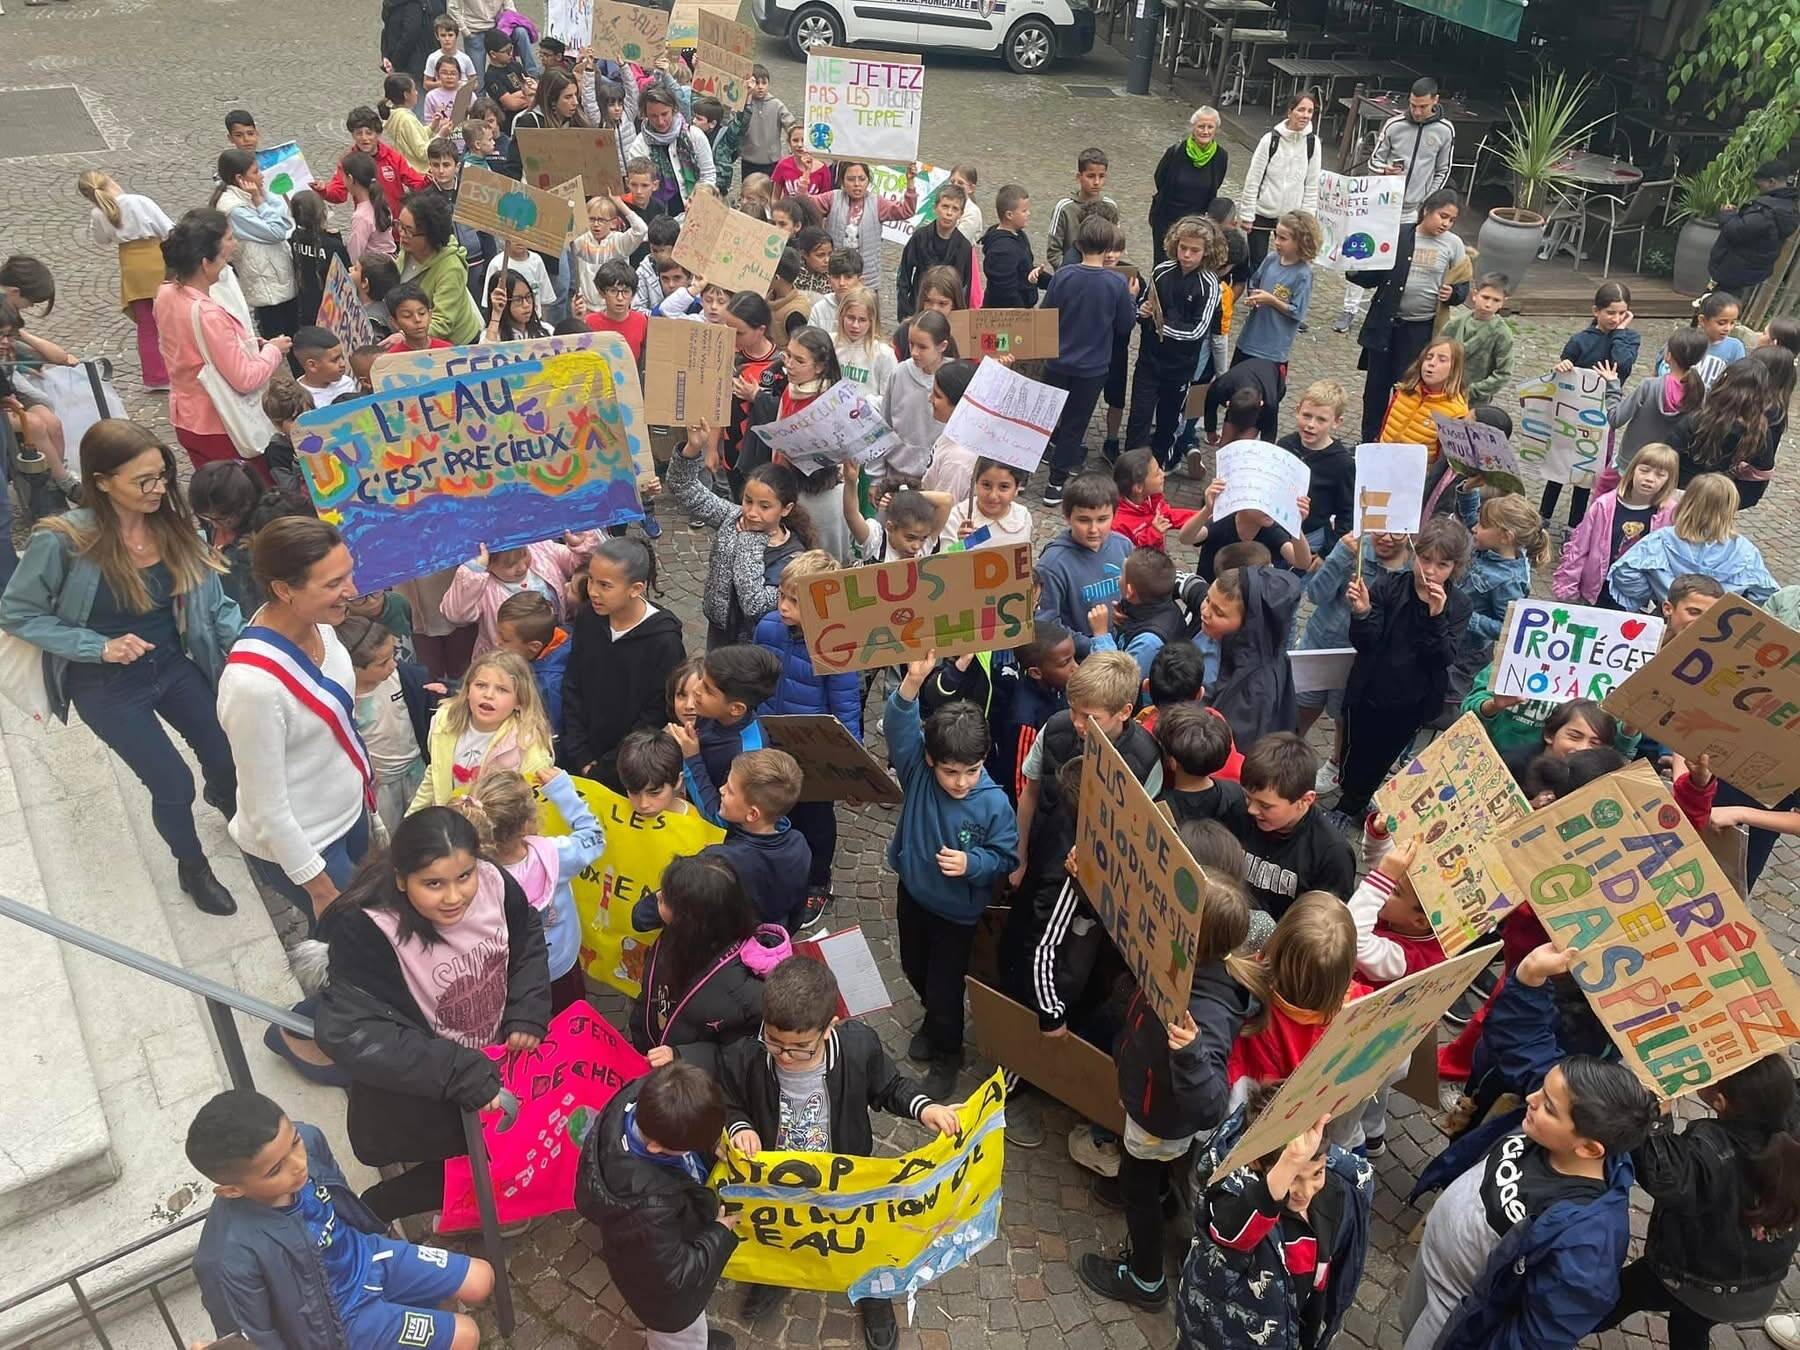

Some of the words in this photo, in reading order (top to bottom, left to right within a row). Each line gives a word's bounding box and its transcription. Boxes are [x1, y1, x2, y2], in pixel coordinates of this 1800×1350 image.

[808, 85, 839, 104] PAS
[846, 86, 870, 107] LES
[816, 59, 841, 84] NE
[849, 61, 923, 89] JETEZ
[808, 105, 833, 122] PAR
[371, 377, 516, 444] L'EAU
[356, 457, 438, 504] C'EST
[809, 554, 946, 620] PLUS
[973, 546, 1031, 590] DE
[1503, 662, 1561, 695] NOS
[611, 803, 666, 831] LES
[1086, 731, 1127, 808] PLUS
[1145, 819, 1170, 875] DE
[1083, 815, 1131, 904] MOIN
[1138, 902, 1158, 950] DE
[1244, 851, 1298, 900] UMA
[1598, 868, 1667, 942] DE
[1620, 831, 1800, 1054] ARRÊTEZ
[1529, 862, 1713, 1097] GASPILLER
[404, 1317, 417, 1340] FIFA
